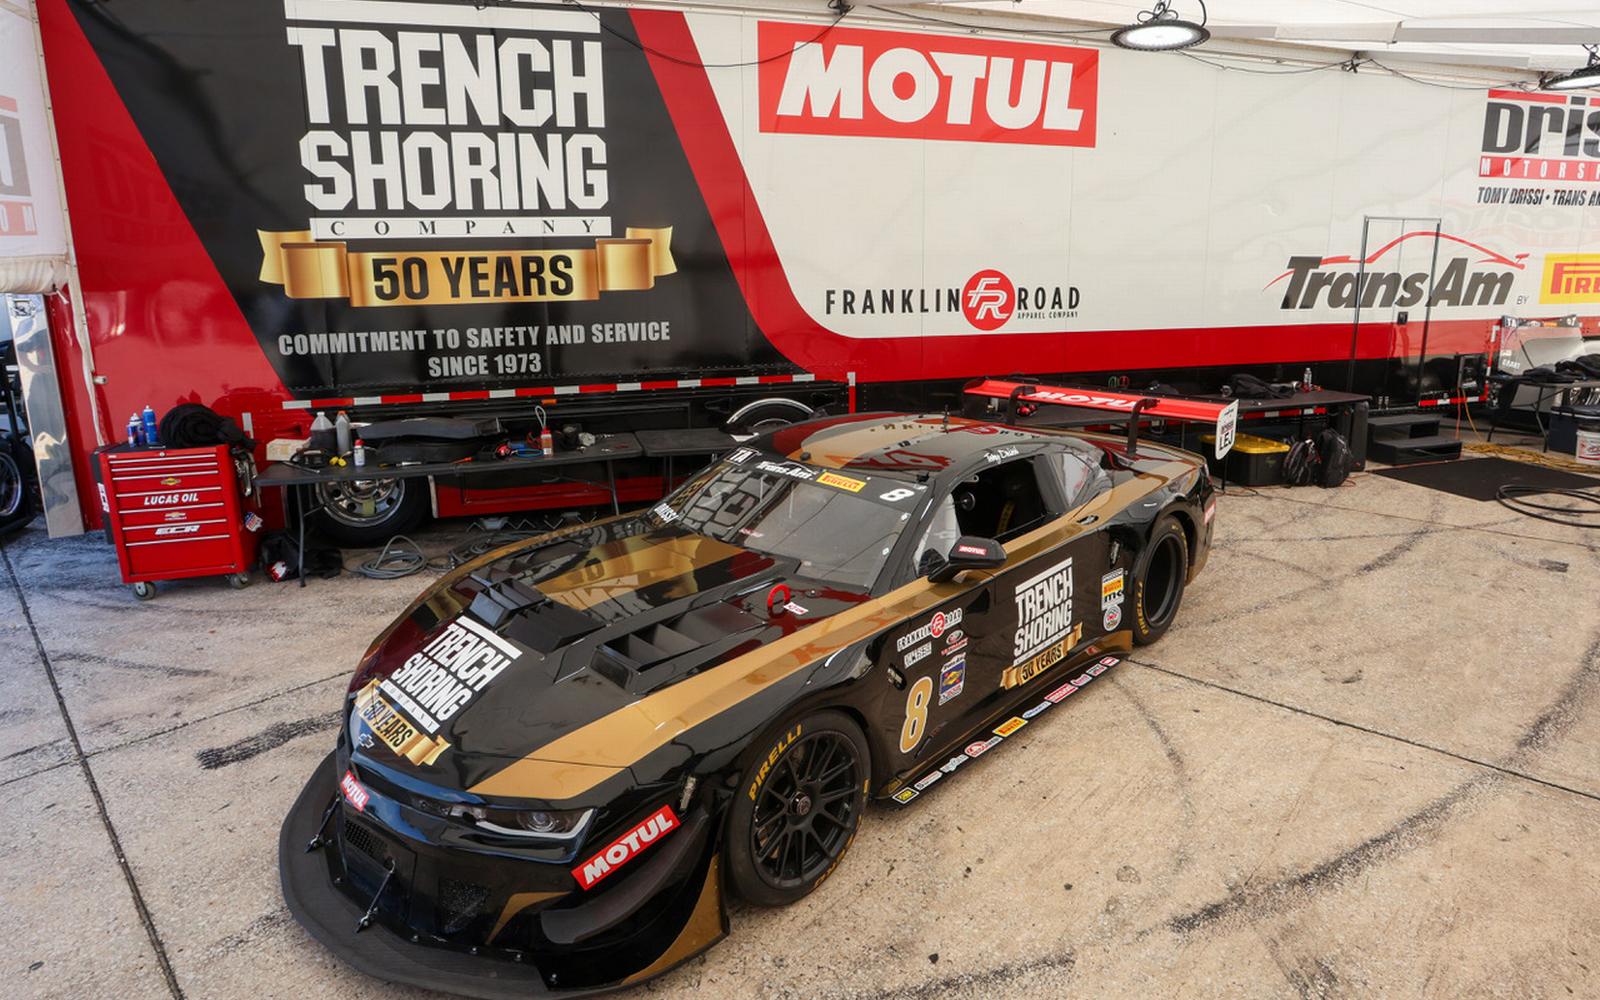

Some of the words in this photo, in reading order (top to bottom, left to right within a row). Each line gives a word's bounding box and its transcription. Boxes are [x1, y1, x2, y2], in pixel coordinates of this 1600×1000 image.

[287, 27, 606, 128] TRENCH
[776, 41, 1084, 131] MOTUL
[299, 130, 608, 211] SHORING
[1477, 187, 1509, 204] TOMY
[1509, 188, 1545, 205] DRISSI
[1552, 189, 1587, 206] TRANS
[331, 218, 595, 237] COMPANY
[374, 256, 428, 300] 50
[440, 254, 574, 299] YEARS
[825, 288, 960, 315] FRANKLIN
[1017, 286, 1080, 311] ROAD
[1017, 312, 1046, 320] APPAREL
[1048, 311, 1078, 319] COMPANY
[1516, 295, 1529, 305] BY
[278, 330, 428, 356] COMMITMENT
[433, 329, 461, 350] TO
[466, 326, 540, 348] SAFETY
[546, 324, 586, 345] AND
[591, 321, 671, 343] SERVICE
[428, 354, 489, 378] SINCE
[494, 352, 542, 375] 1973
[1027, 391, 1137, 409] MOTU
[144, 494, 180, 506] LUCAS
[182, 492, 199, 503] OIL
[879, 488, 915, 502] 8
[1015, 567, 1073, 627] TRENCH
[1014, 599, 1072, 657] SHORING
[423, 623, 512, 692] TRENCH
[1021, 663, 1034, 681] 50
[1035, 643, 1064, 676] YEARS
[391, 652, 473, 721] SHORING
[374, 706, 413, 748] YEARS
[900, 676, 934, 754] 8
[749, 723, 802, 801] PIRELLI
[341, 774, 367, 808] MOTUL
[583, 812, 673, 884] MOTUL
